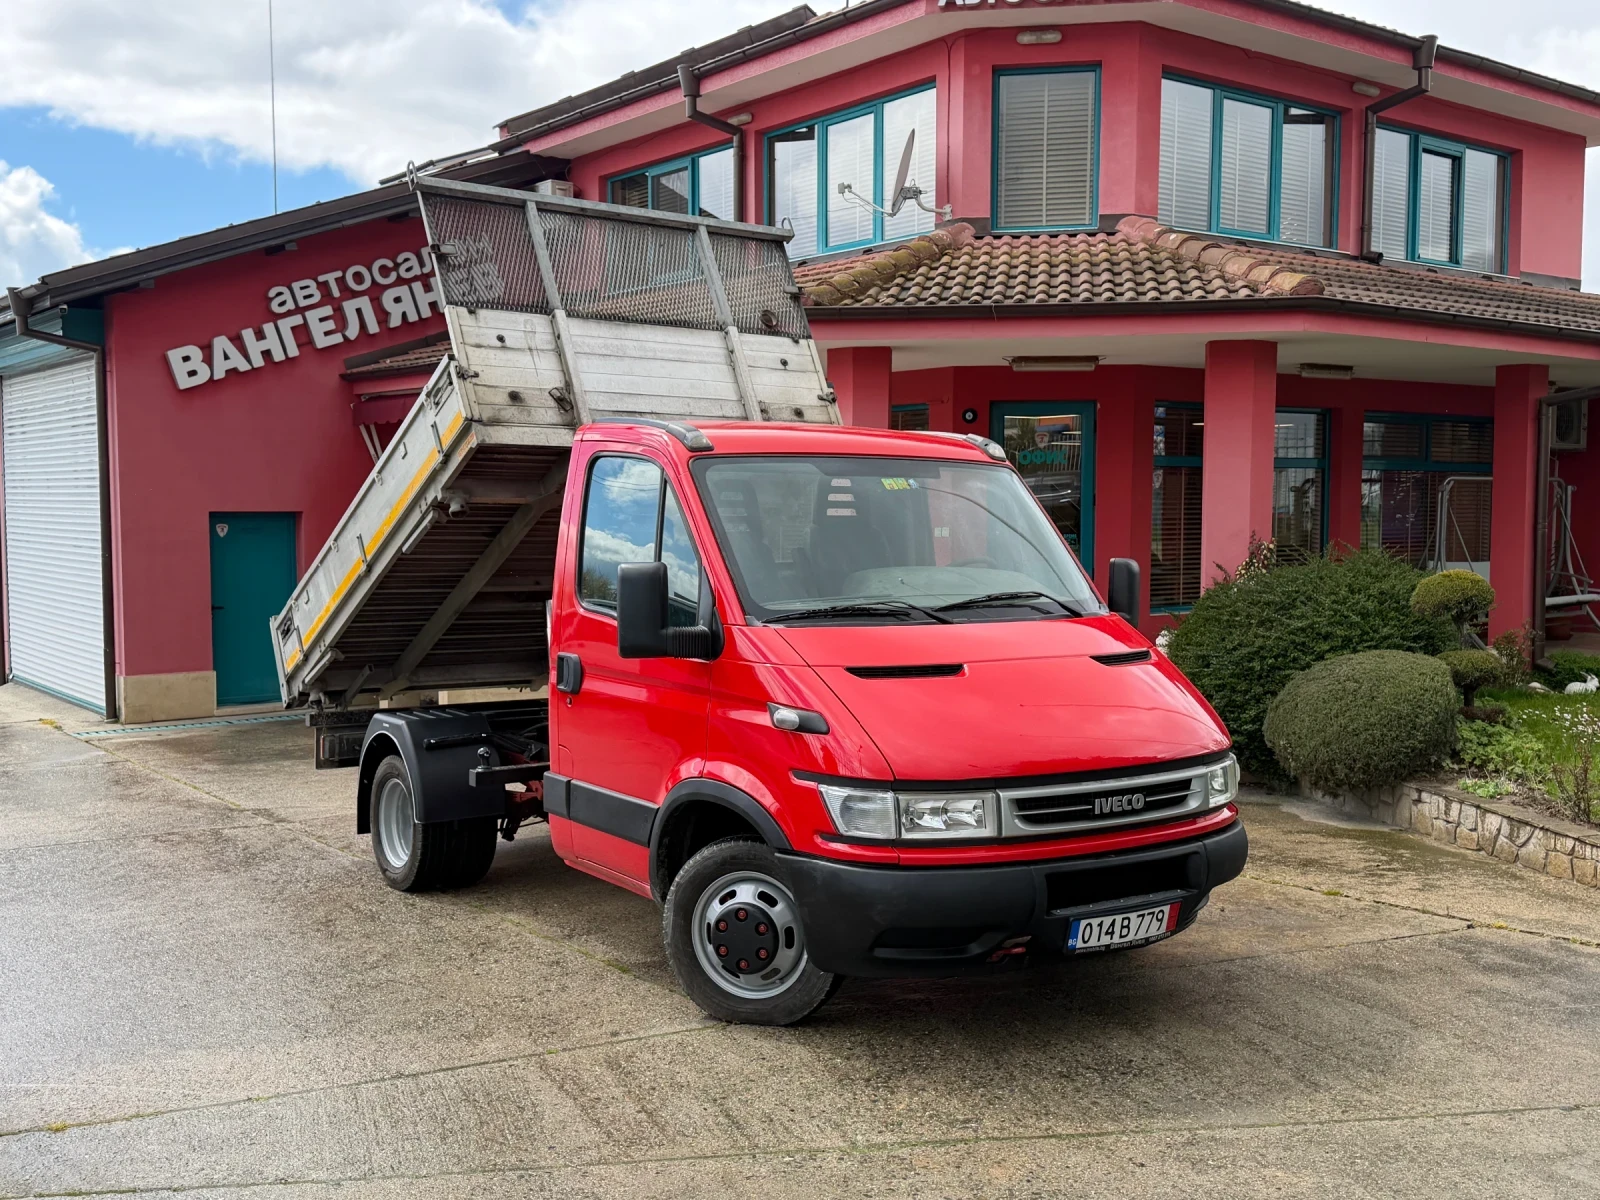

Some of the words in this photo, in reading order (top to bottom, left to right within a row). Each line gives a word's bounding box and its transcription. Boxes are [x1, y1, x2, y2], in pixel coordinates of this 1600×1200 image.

[165, 295, 380, 390] ВАНГЕЛ
[1019, 449, 1067, 465] ОФИС
[1094, 793, 1145, 815] IVECO
[1068, 937, 1077, 947] BG
